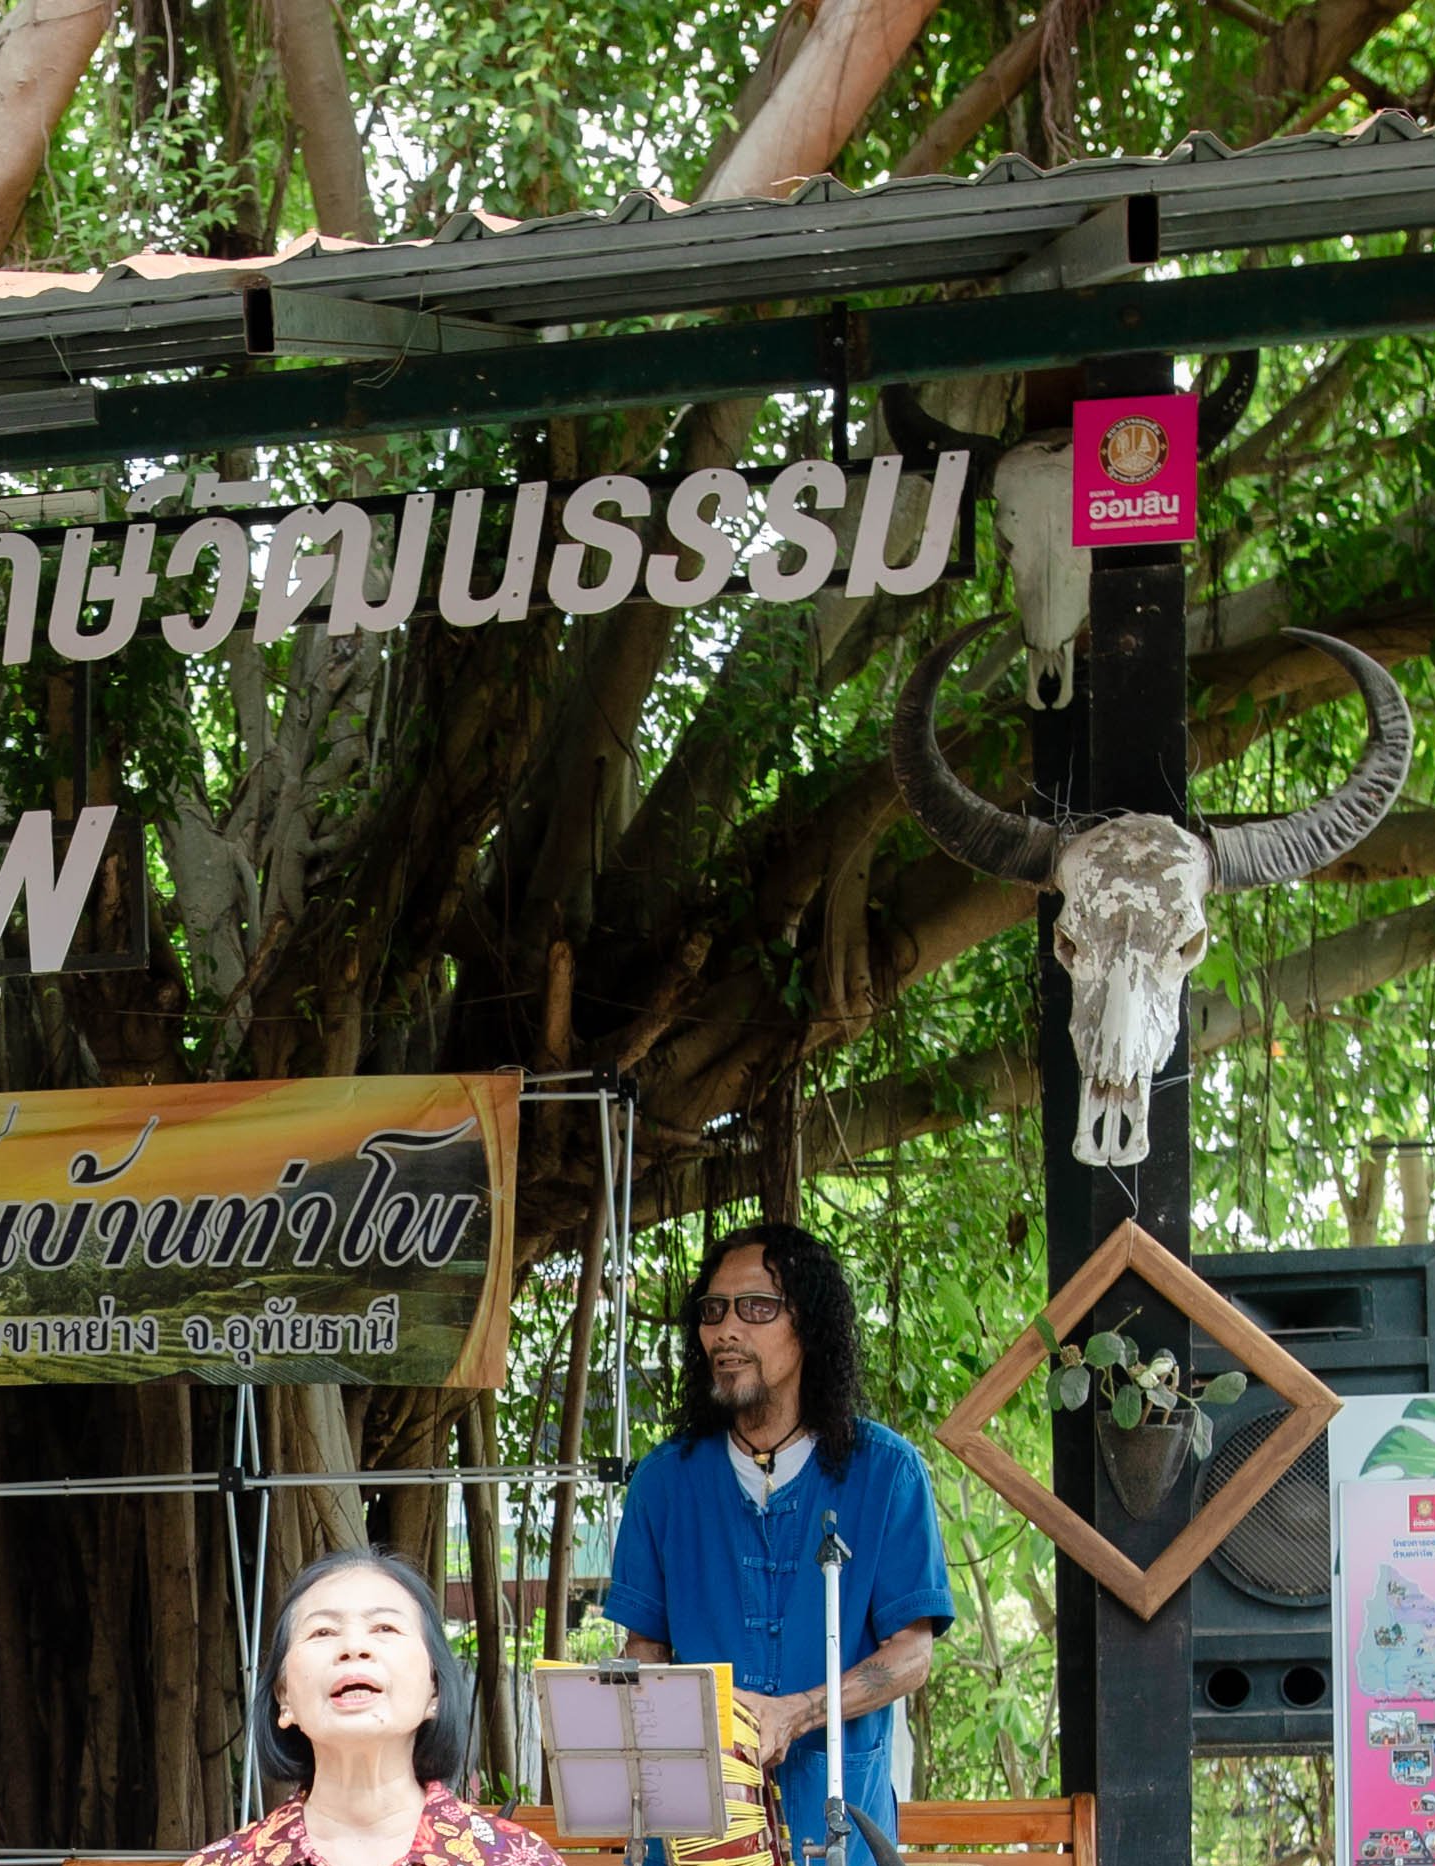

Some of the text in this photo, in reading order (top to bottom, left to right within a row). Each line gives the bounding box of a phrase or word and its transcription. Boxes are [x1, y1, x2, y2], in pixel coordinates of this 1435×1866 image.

[1089, 491, 1179, 520] ออมสิน
[185, 1297, 398, 1367] จ.อุทัยธานี
